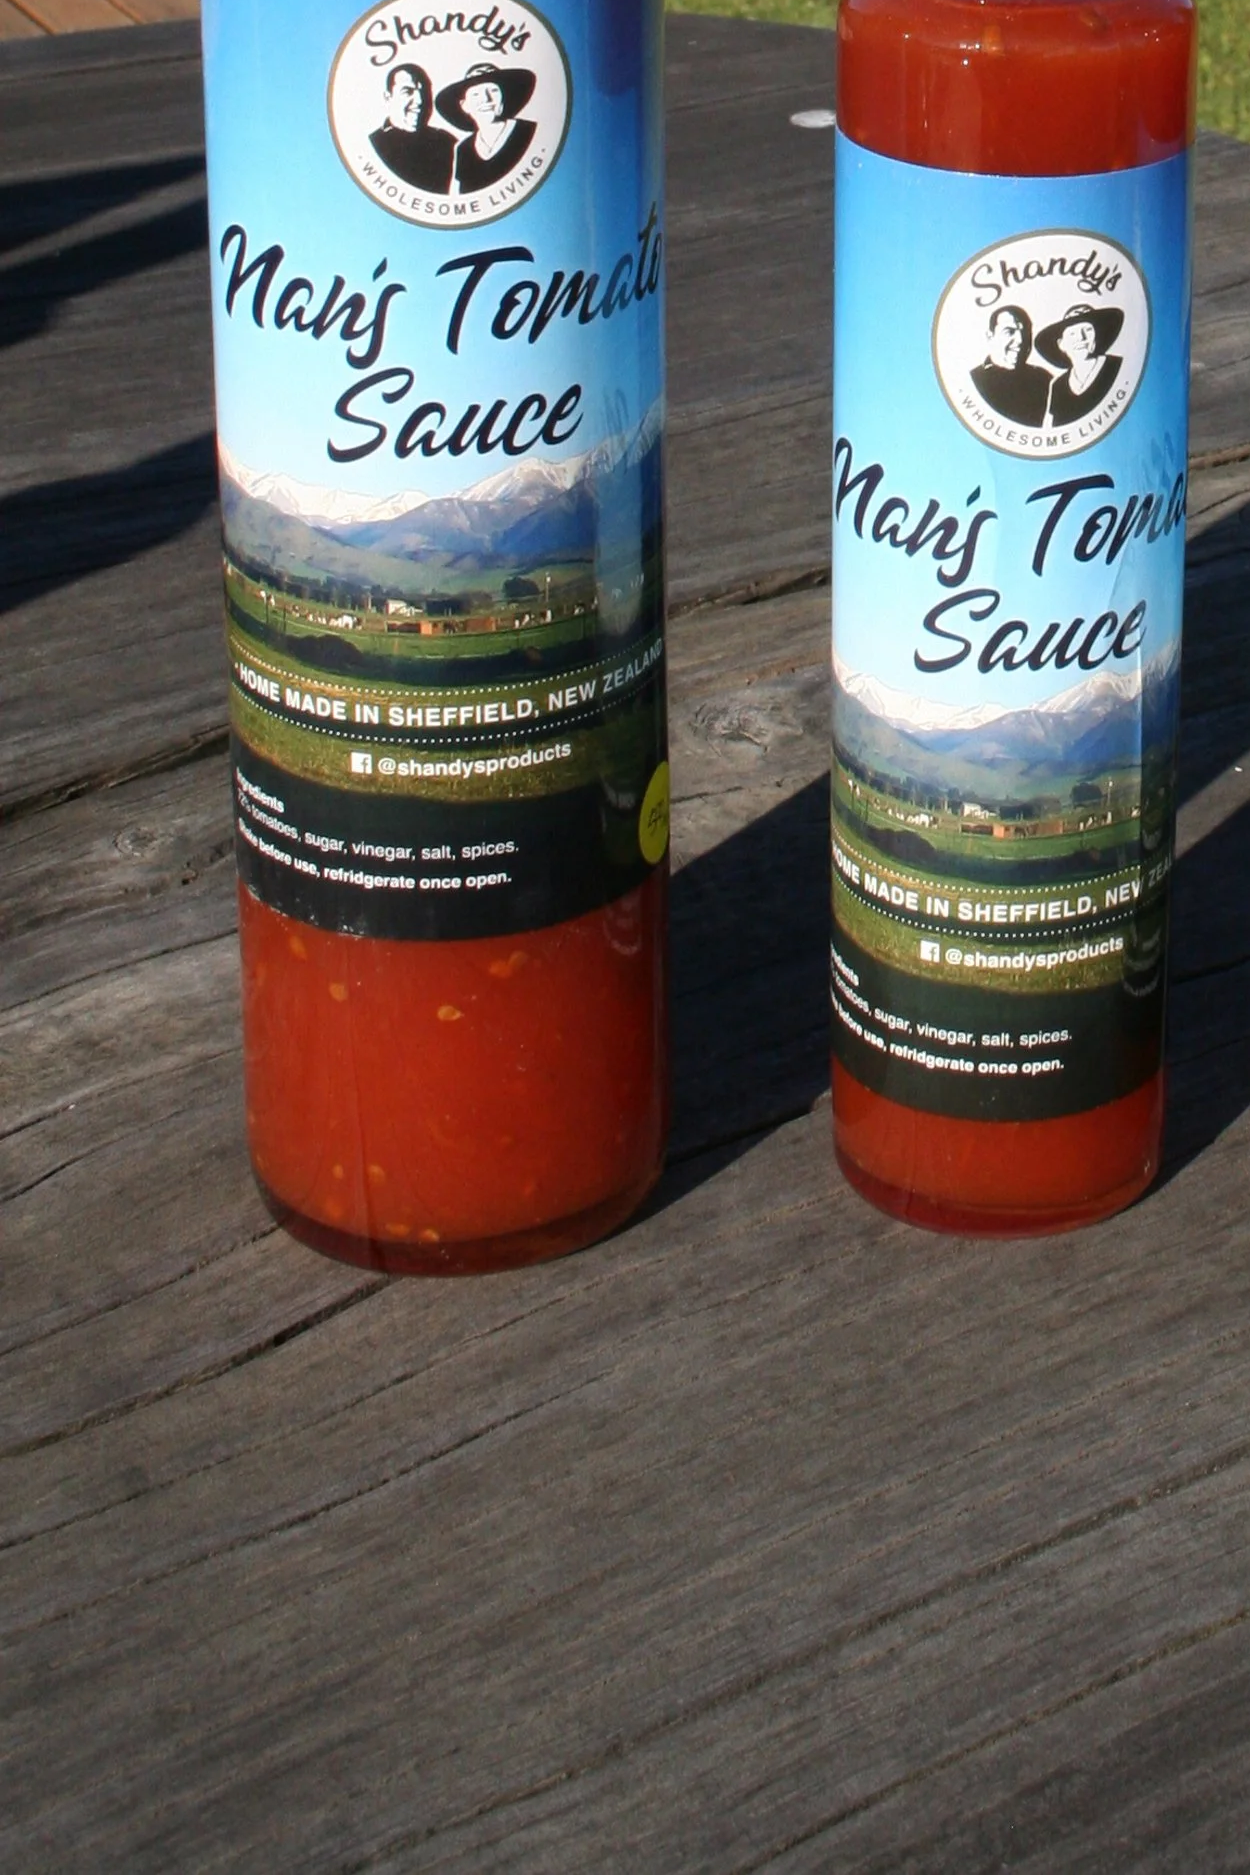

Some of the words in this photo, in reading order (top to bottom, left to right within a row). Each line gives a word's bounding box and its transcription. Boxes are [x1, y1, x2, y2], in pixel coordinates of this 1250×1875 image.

[366, 6, 531, 66] Shandy's
[363, 161, 481, 216] WHOLESOME
[491, 154, 544, 206] LIVING
[220, 225, 407, 369] Nan's
[435, 201, 662, 355] Tomato
[971, 250, 1122, 307] Shandy's
[327, 367, 583, 463] Sauce
[961, 395, 1071, 447] WHOLESOME
[1079, 388, 1127, 438] LIVING
[834, 437, 998, 587] Nan's
[1026, 472, 1186, 577] Toma
[914, 588, 1146, 674] Sauce
[239, 666, 280, 702] HOME
[286, 688, 346, 720] MADE
[355, 703, 379, 724] IN
[389, 699, 539, 727] SHEFFIELD,
[548, 680, 596, 711] NEW
[603, 638, 663, 693] ZEALAND
[377, 741, 571, 779] @shandysproducts
[294, 857, 320, 878] use,
[323, 867, 415, 889] refridgerate
[419, 875, 461, 890] once
[466, 871, 512, 890] open.
[304, 832, 347, 854] sugar,
[352, 839, 416, 862] vinegar,
[421, 844, 455, 862] salt,
[462, 839, 519, 860] spices.
[864, 872, 918, 911] MADE
[926, 896, 949, 918] IN
[958, 896, 1097, 923] SHEFFIELD,
[1105, 877, 1144, 908] NEW
[945, 936, 1124, 972] @shandysproducts
[917, 1023, 976, 1046] vinegar,
[981, 1032, 1014, 1048] salt,
[1019, 1028, 1072, 1048] spices.
[978, 1061, 1018, 1075] once
[1022, 1057, 1064, 1075] open.
